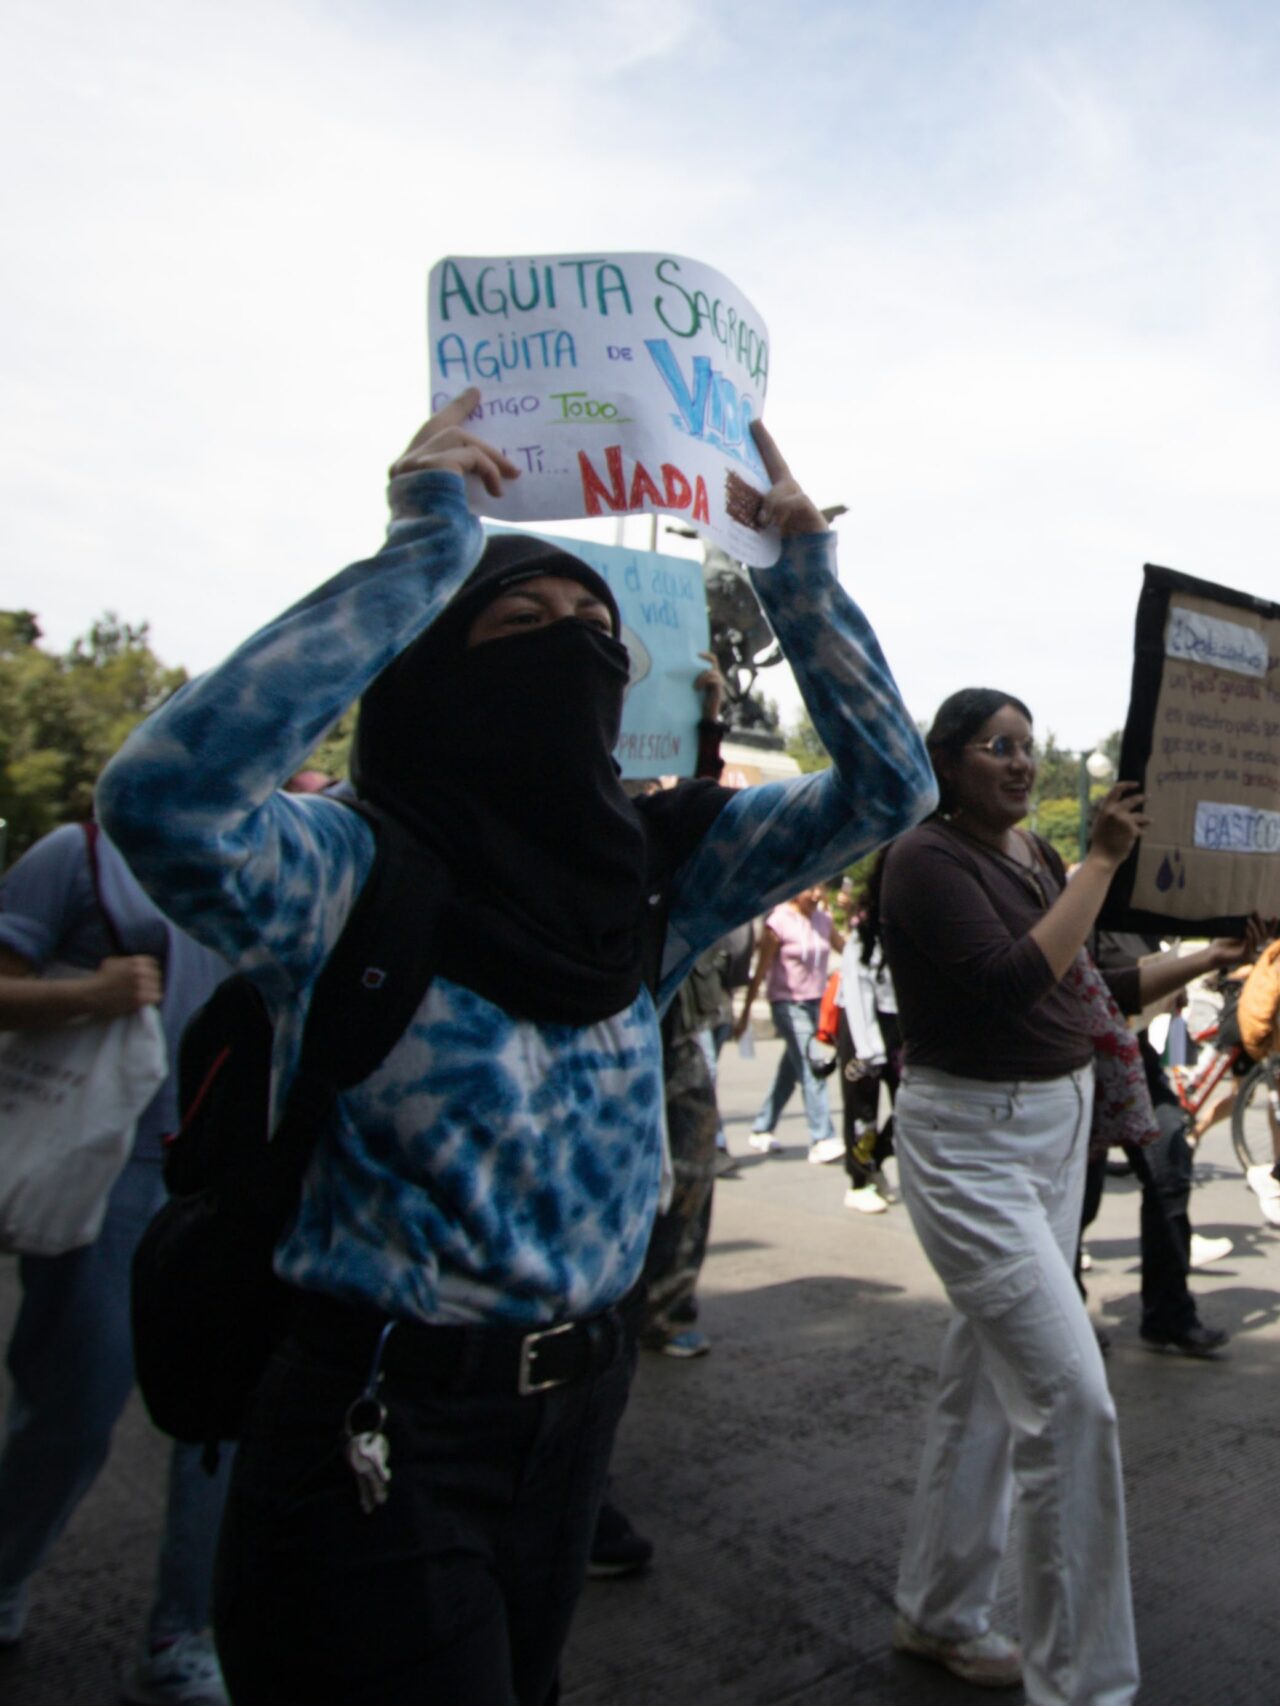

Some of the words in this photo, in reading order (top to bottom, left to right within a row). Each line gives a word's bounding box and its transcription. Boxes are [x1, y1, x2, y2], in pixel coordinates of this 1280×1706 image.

[437, 329, 578, 382] AGÜITA
[606, 345, 634, 361] DE
[439, 259, 633, 322] AGÜITA
[654, 258, 769, 399] SAGRADA
